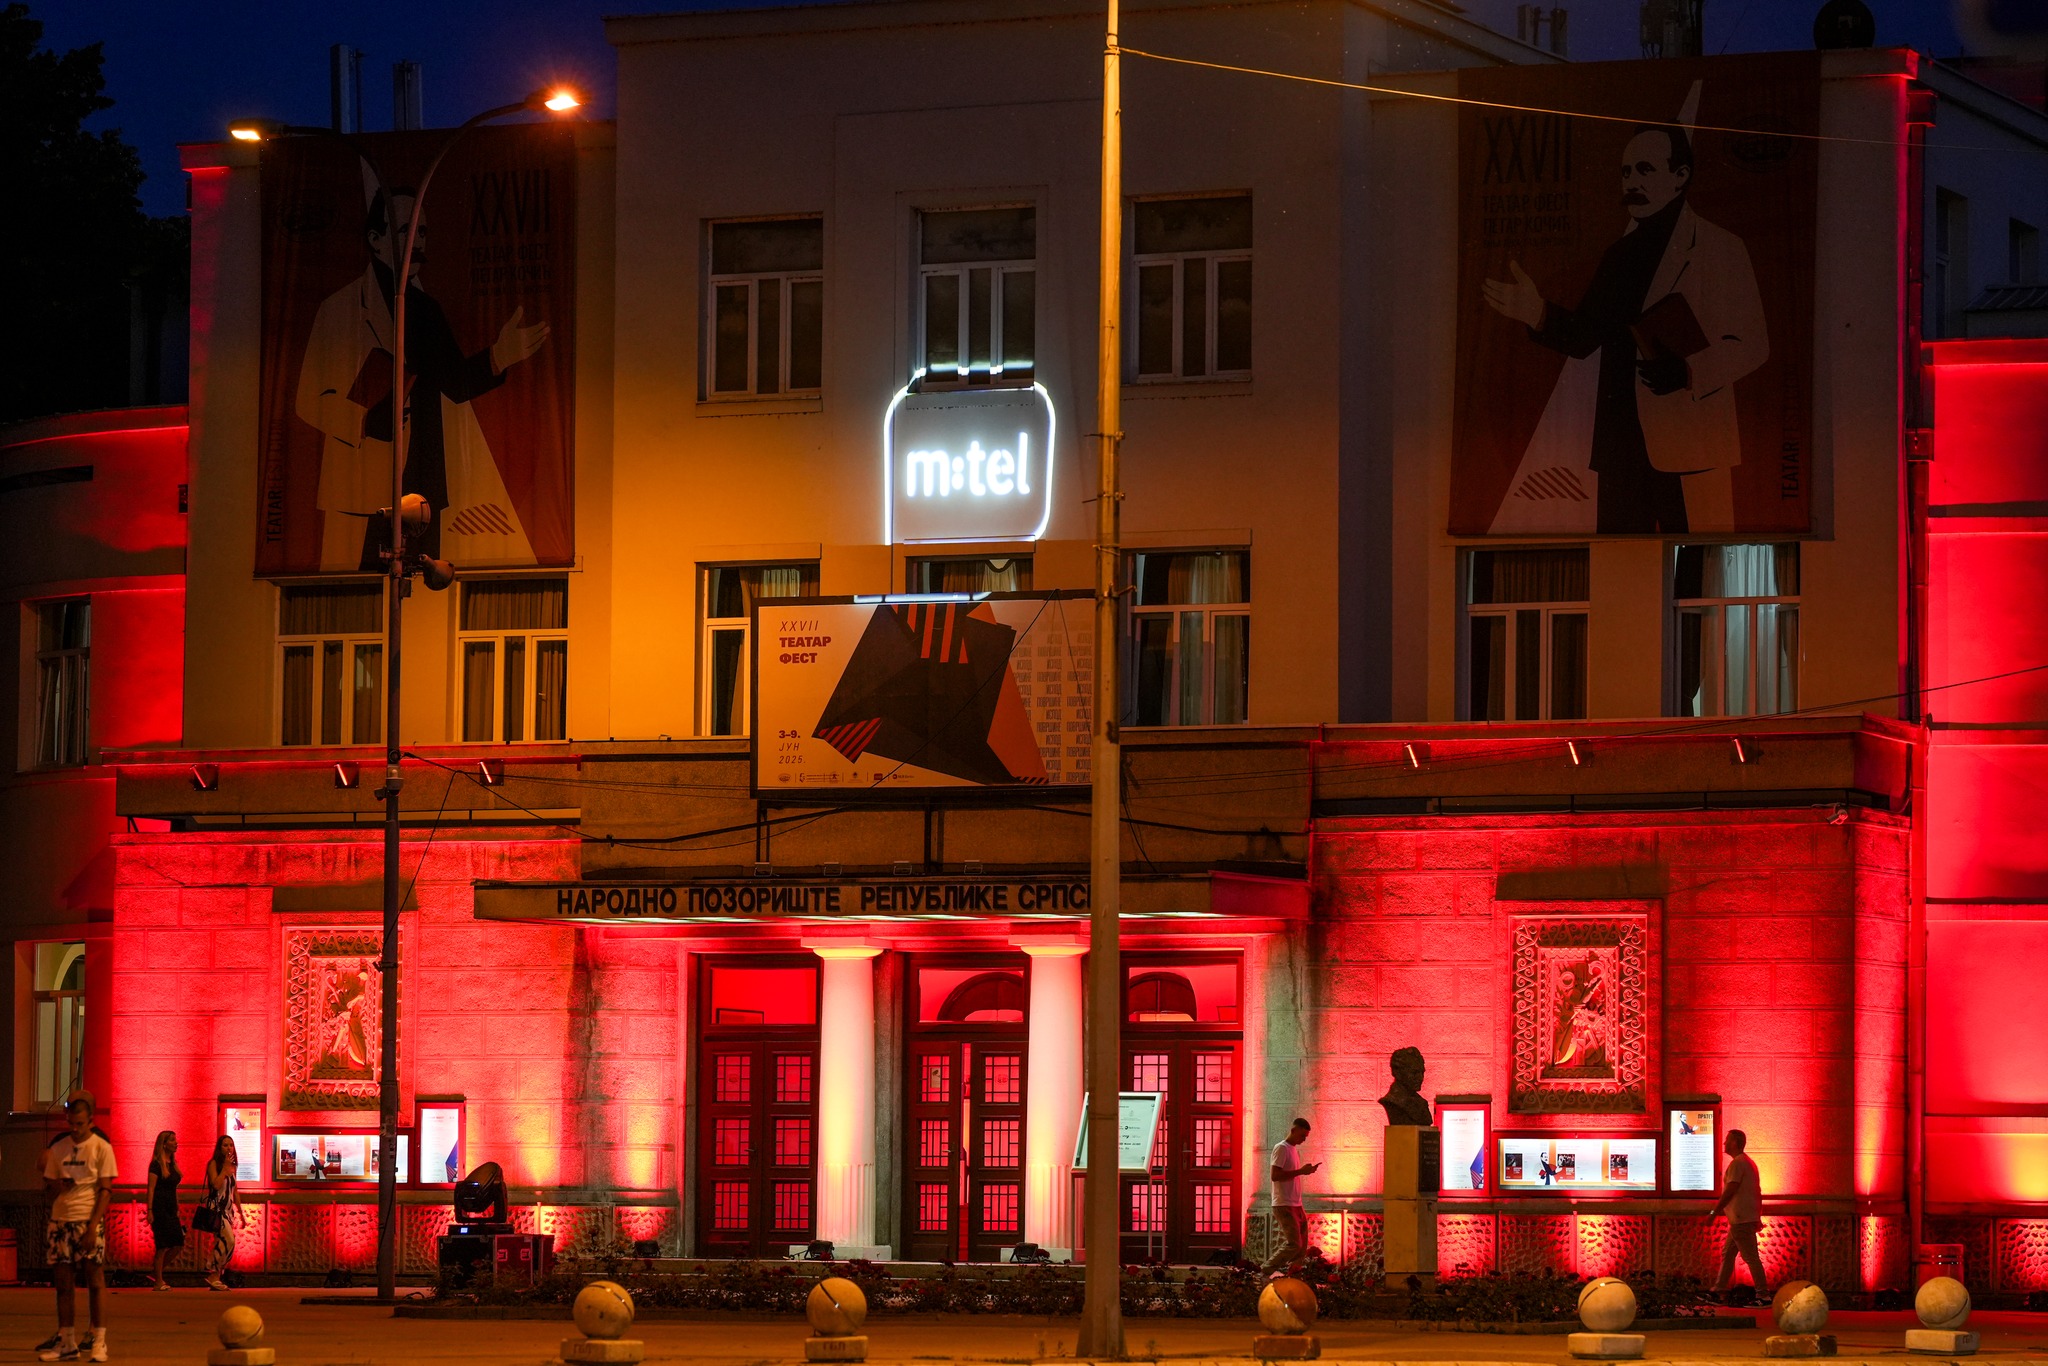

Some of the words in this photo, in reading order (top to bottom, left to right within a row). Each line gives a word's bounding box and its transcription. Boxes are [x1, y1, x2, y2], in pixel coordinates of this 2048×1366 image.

[1483, 115, 1571, 184] XXVII
[471, 169, 550, 236] XXVII
[1482, 194, 1530, 213] ТЕАТАР
[1534, 192, 1570, 212] ФЕСТ
[907, 432, 1030, 497] m:tel
[779, 620, 819, 632] XXVII
[779, 636, 832, 647] ТЕАТАР
[779, 653, 818, 664] ФЕСТ
[778, 755, 806, 764] 2025.
[557, 889, 677, 915] НАРОДНО
[688, 887, 840, 914] ПОЗОРИШТЕ
[861, 885, 1008, 912] РЕПУБЛИКЕ
[1018, 884, 1091, 910] СРПС
